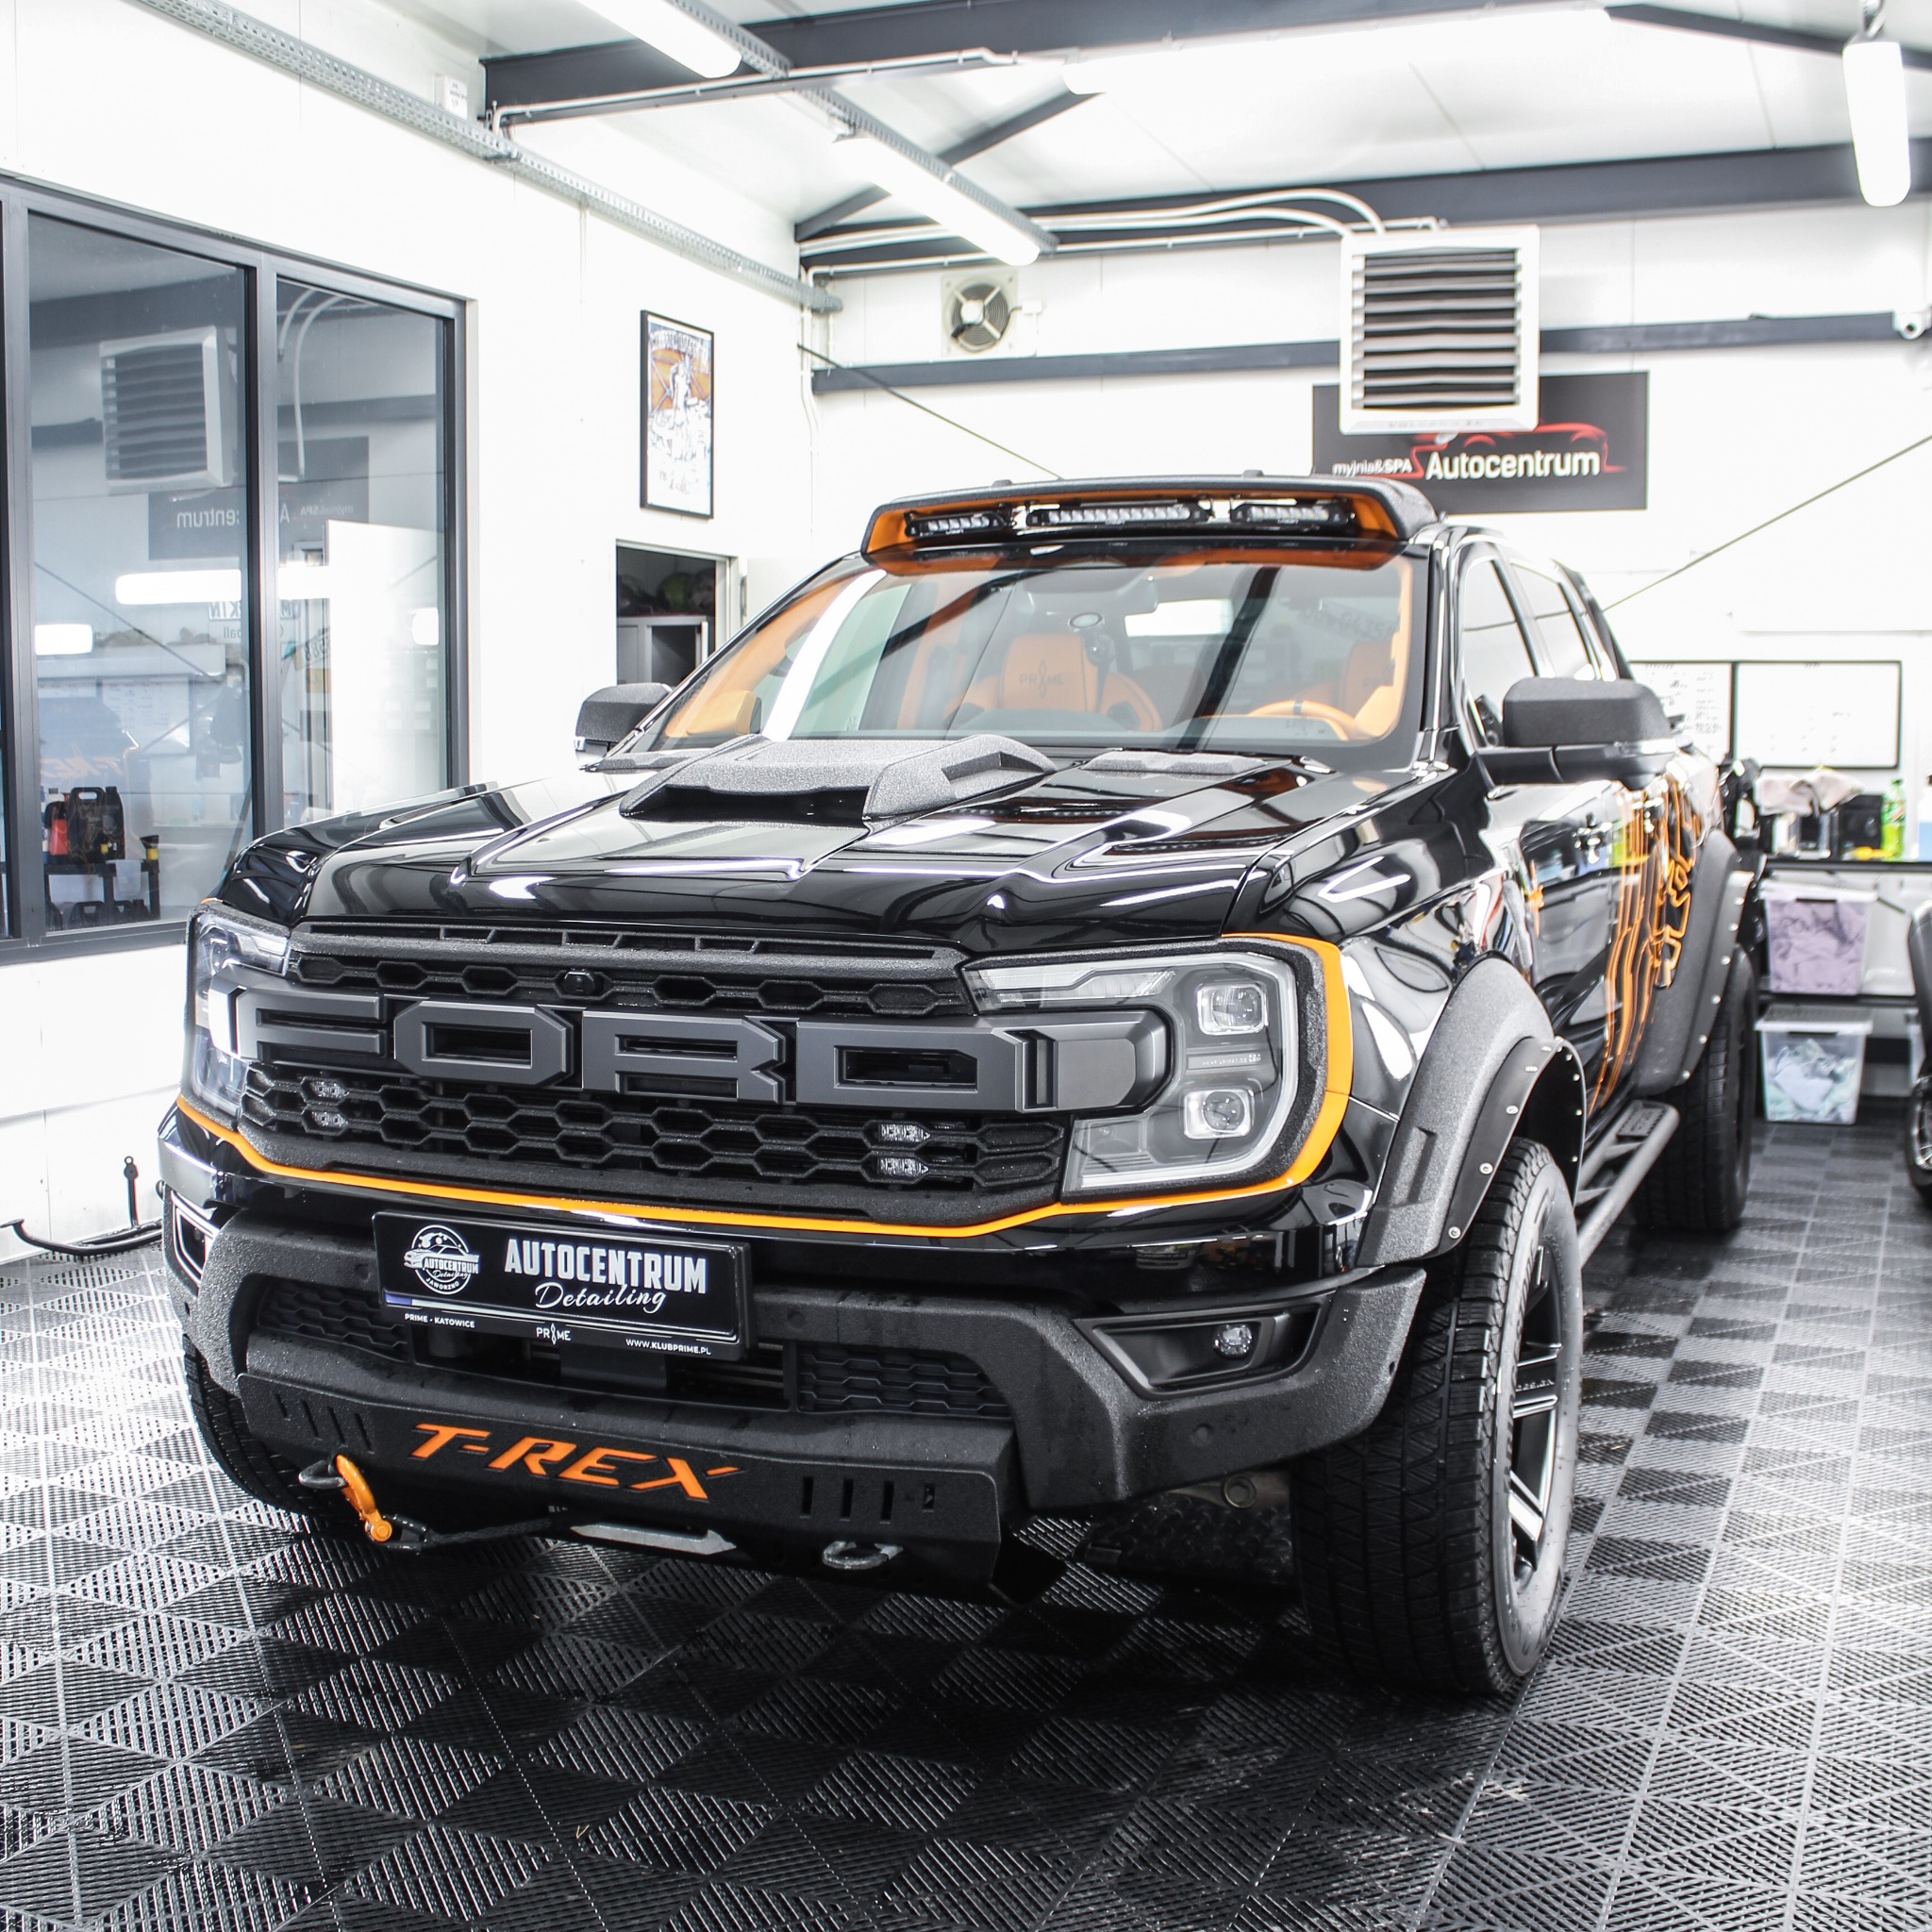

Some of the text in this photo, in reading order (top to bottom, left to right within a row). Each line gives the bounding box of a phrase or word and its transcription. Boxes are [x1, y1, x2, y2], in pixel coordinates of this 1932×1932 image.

[1425, 451, 1600, 480] Autocentrum
[234, 985, 1024, 1109] FORD
[424, 1257, 478, 1274] AUTOCENTRUM
[505, 1239, 708, 1293] AUTOCENTRUM
[534, 1281, 667, 1314] Detailing
[404, 1313, 428, 1323] PRIME
[434, 1316, 475, 1328] KATOWICE
[625, 1338, 711, 1356] WWW.KLUBPRIME.PL
[410, 1423, 741, 1500] T-REX
